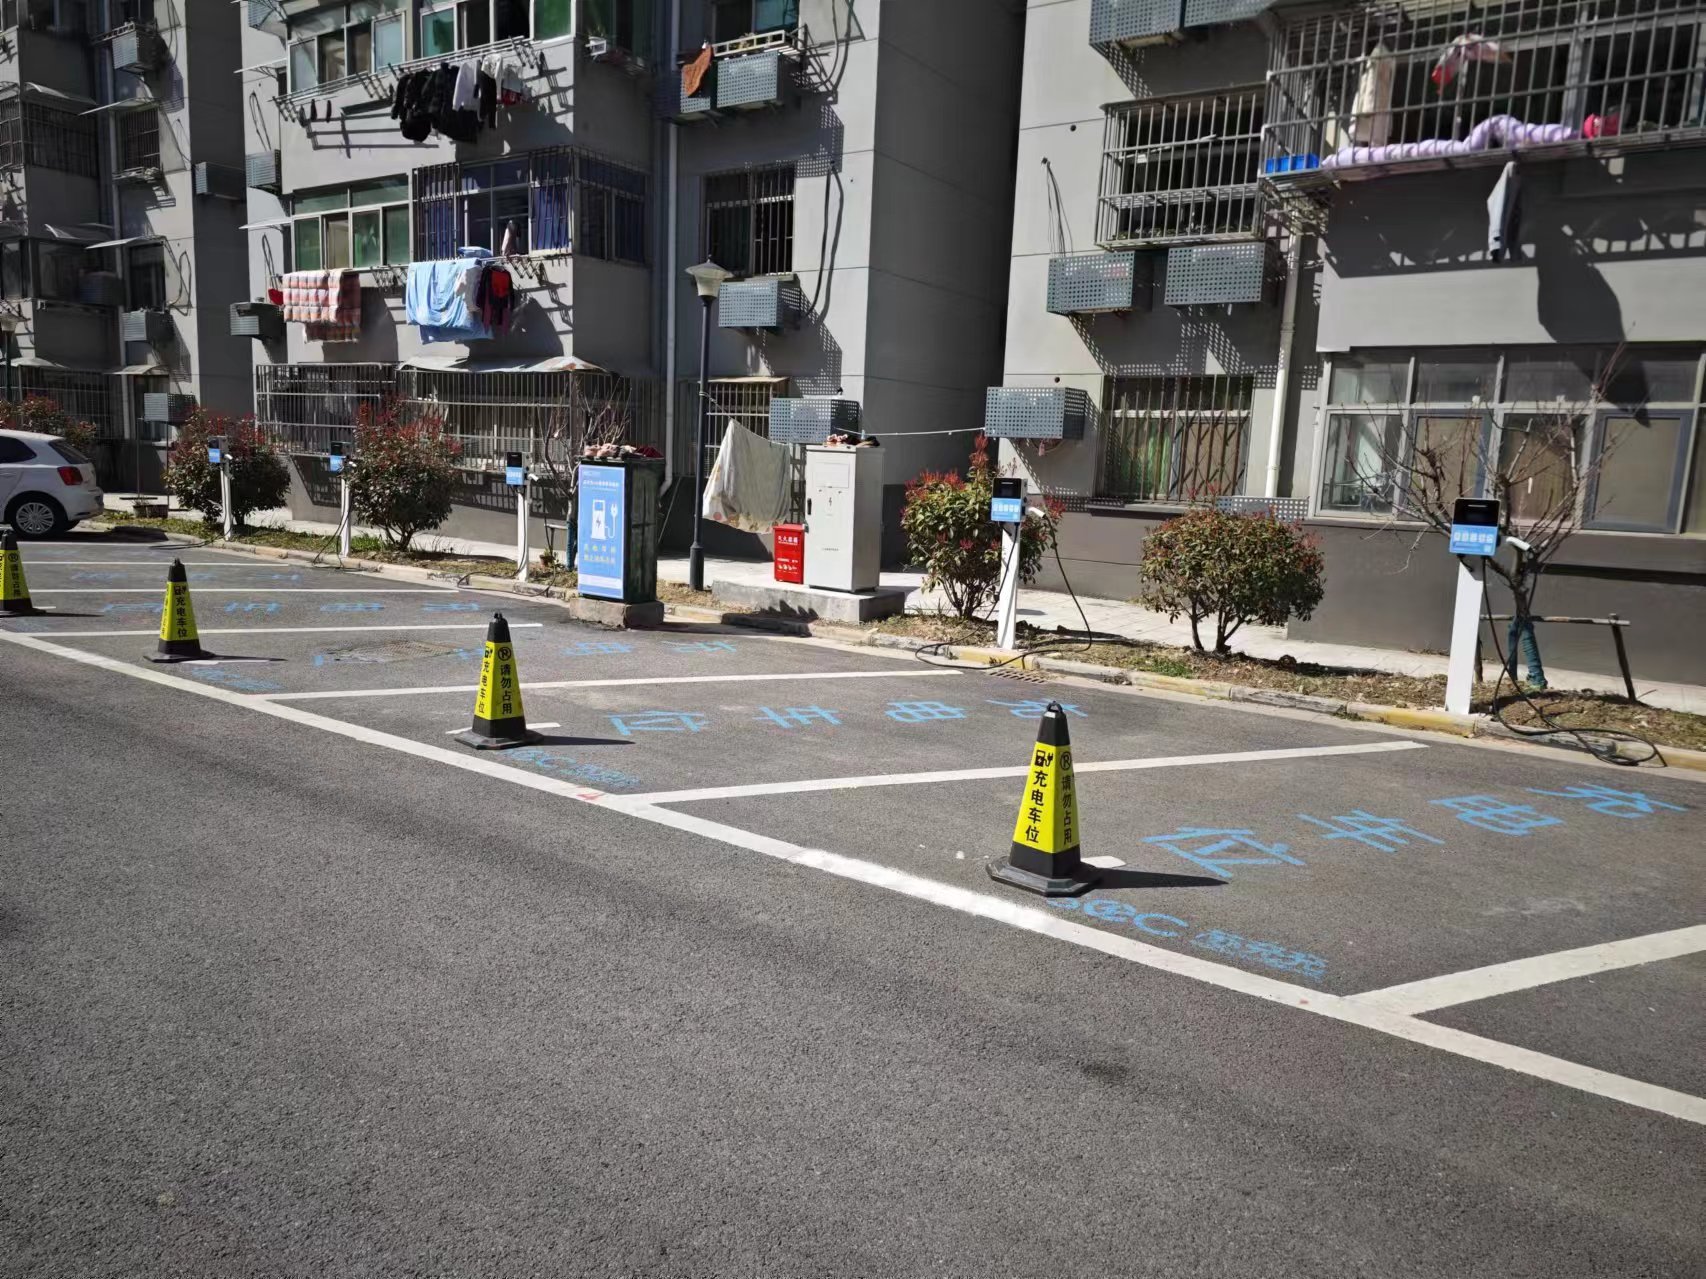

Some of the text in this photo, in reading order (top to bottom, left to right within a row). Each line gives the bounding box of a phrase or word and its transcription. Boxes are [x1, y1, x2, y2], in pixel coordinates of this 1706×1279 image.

[176, 596, 188, 637] 充电车位
[478, 661, 490, 714] 充电车位
[500, 664, 512, 715] 请勿占用
[1025, 770, 1048, 843] 充电车位
[1061, 775, 1073, 845] 请勿占用
